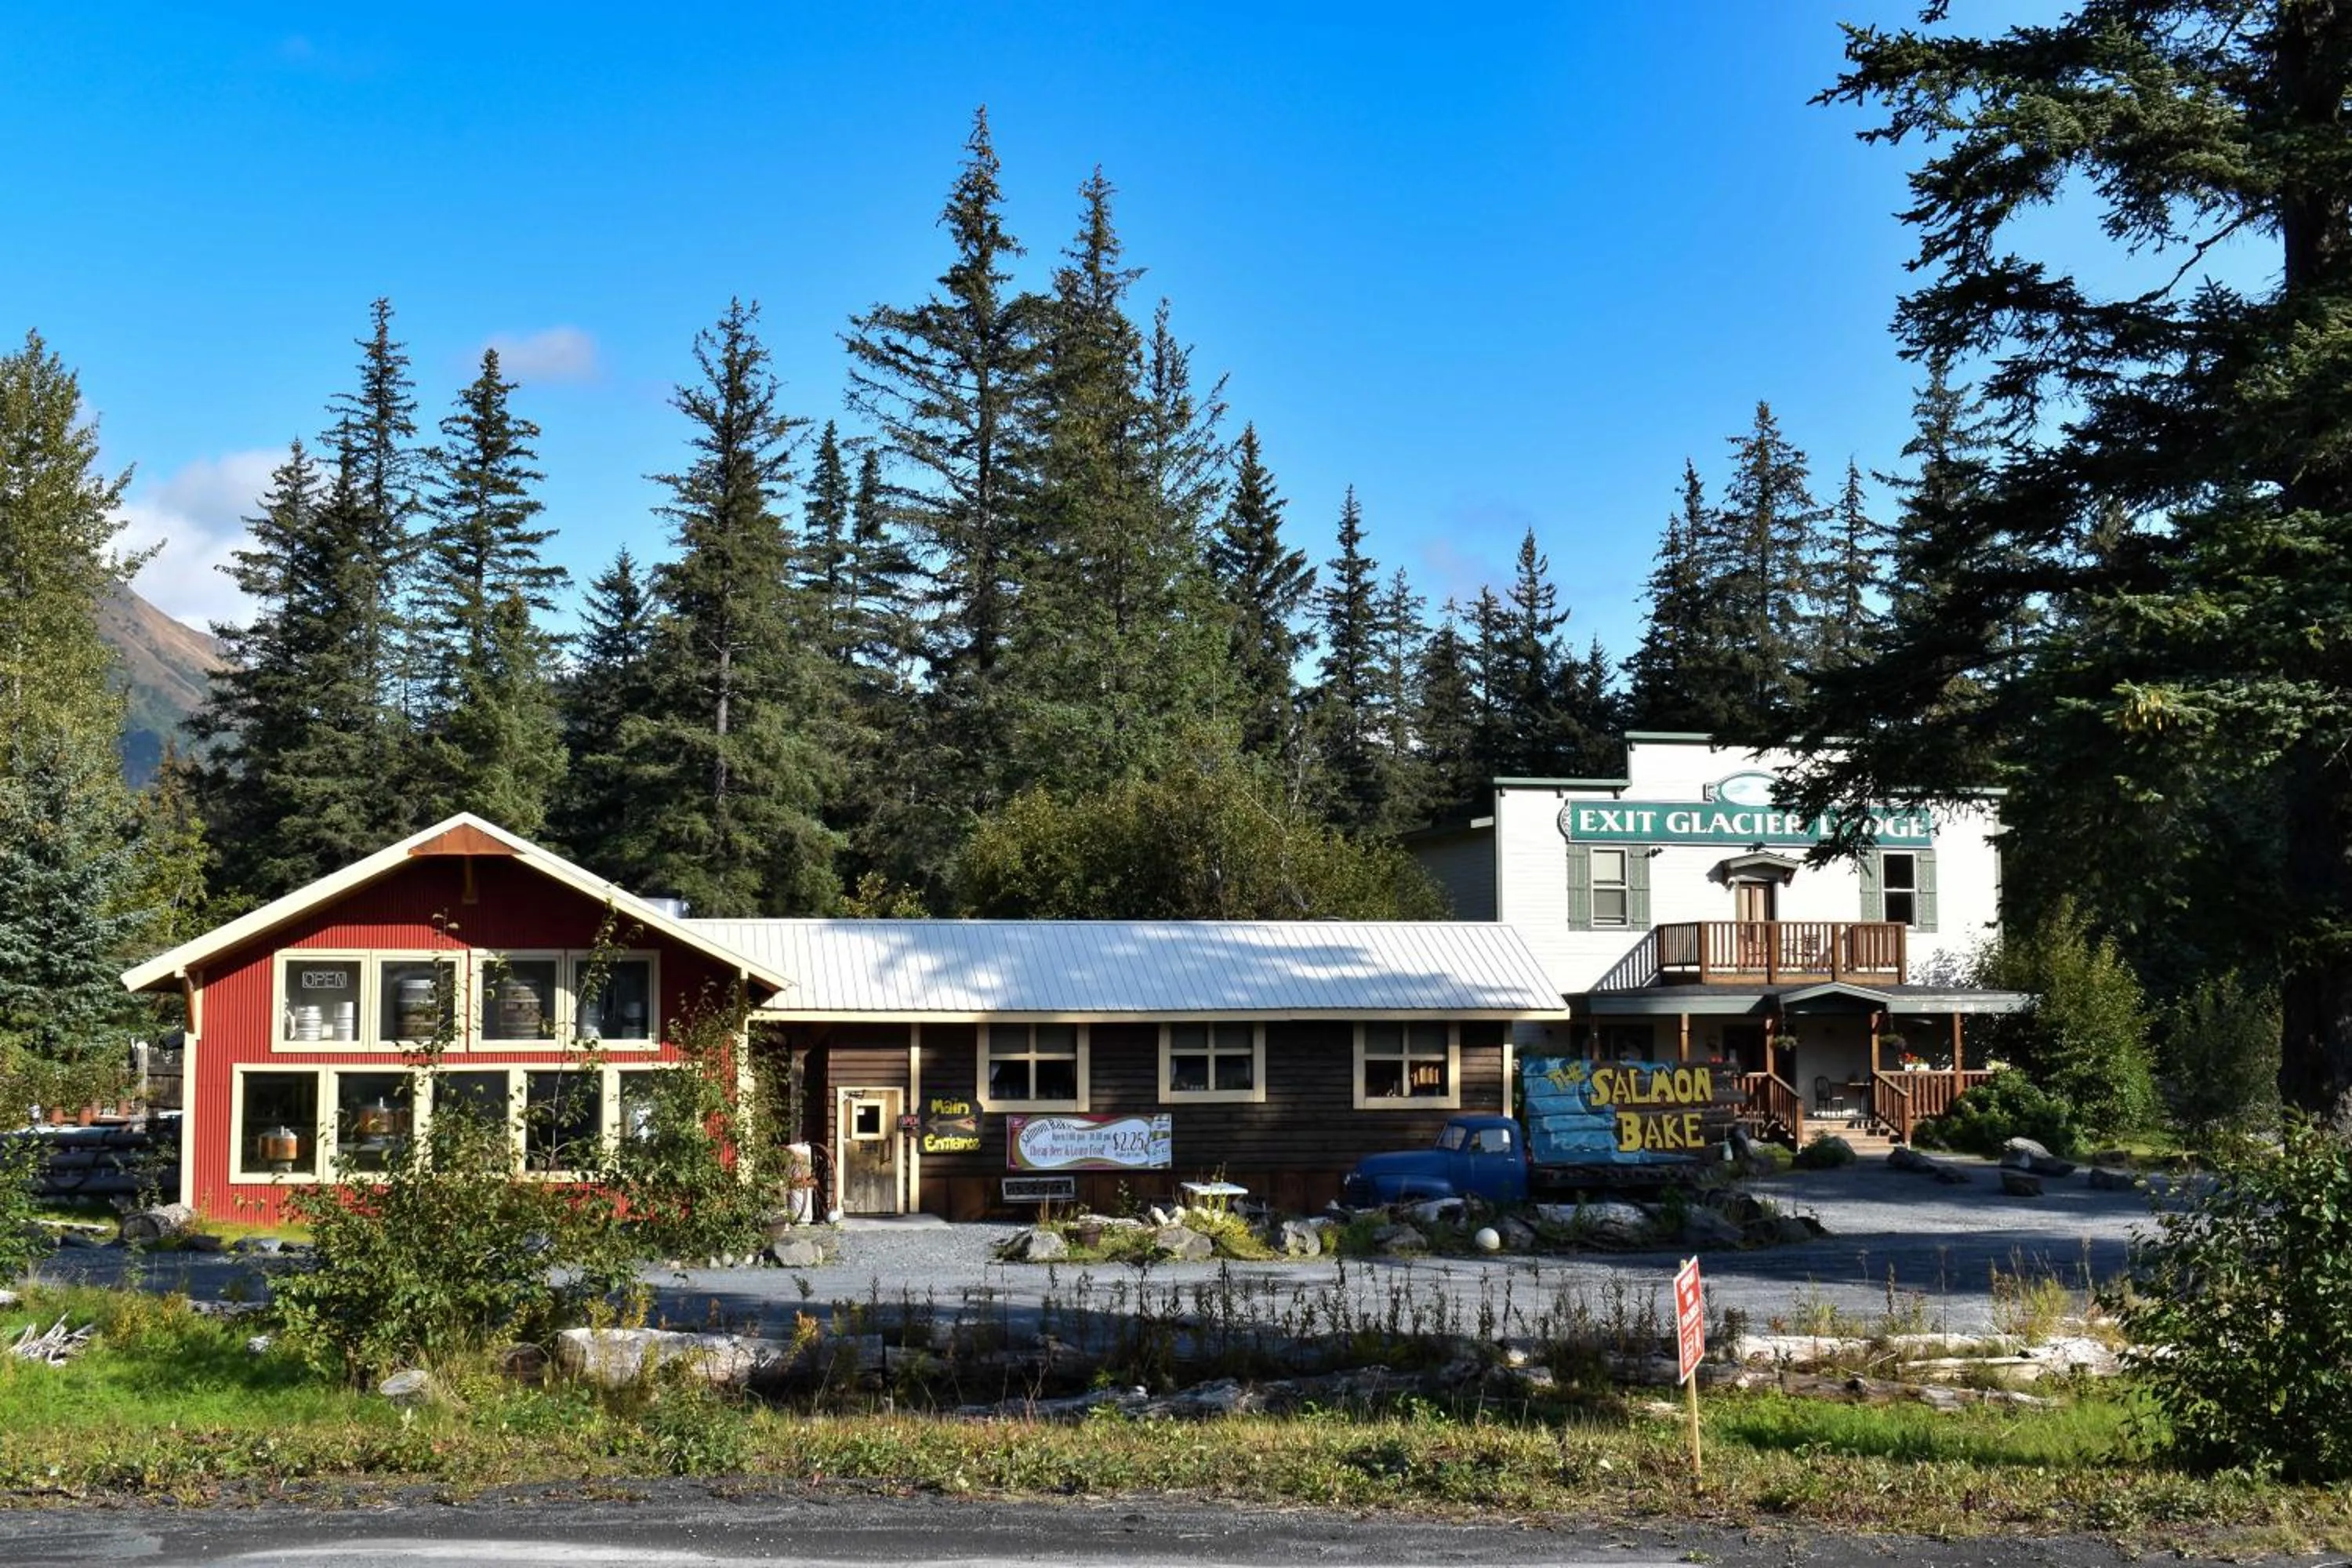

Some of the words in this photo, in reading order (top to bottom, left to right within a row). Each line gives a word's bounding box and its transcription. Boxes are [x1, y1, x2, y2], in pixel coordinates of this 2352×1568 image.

[1579, 808, 1656, 833] EXIT
[1666, 811, 1805, 837] GLACIER
[1820, 814, 1926, 838] LDGE
[305, 973, 343, 986] OPEN
[1548, 1059, 1585, 1092] THE
[1590, 1067, 1713, 1106] SALMON
[931, 1099, 970, 1114] Main
[924, 1133, 980, 1152] Entrance
[1113, 1131, 1145, 1152] $2.25
[1616, 1111, 1705, 1152] BAKE
